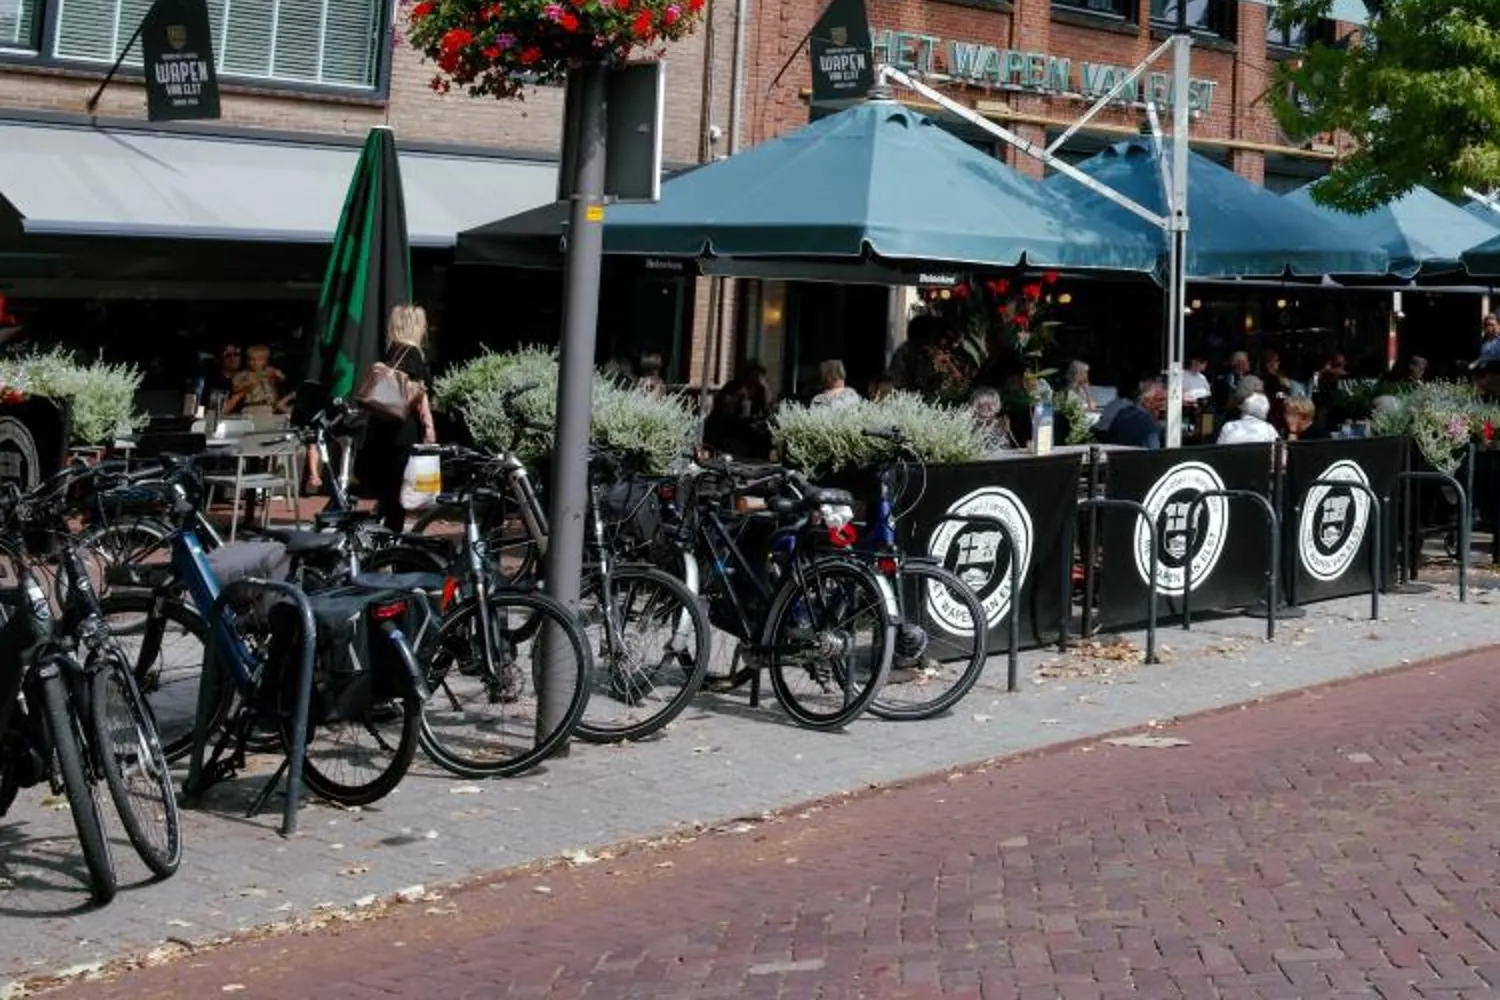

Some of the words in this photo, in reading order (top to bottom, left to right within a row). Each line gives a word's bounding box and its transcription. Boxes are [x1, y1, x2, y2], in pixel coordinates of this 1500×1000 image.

[155, 61, 208, 84] WAPEN
[819, 54, 865, 72] WAPEN
[869, 28, 940, 74] HET
[946, 40, 1070, 90] WAPEN
[1080, 61, 1137, 100] VAN
[941, 599, 969, 623] WAPE
